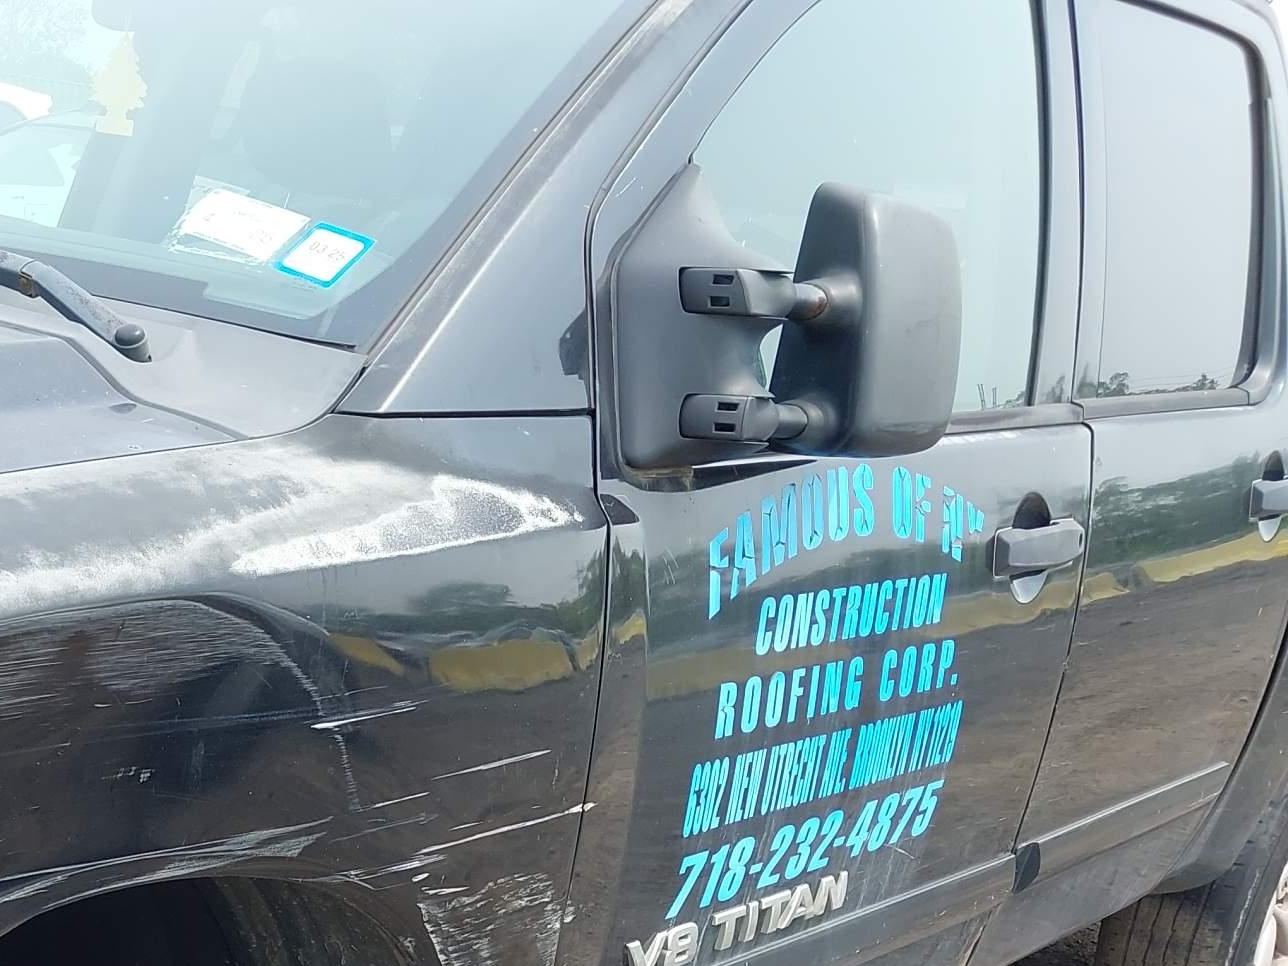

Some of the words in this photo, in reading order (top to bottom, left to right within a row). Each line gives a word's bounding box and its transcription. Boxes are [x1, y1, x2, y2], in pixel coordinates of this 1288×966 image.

[708, 463, 874, 620] FAMOUS
[892, 466, 931, 543] OF
[755, 573, 948, 656] CONSTRUCTION
[714, 656, 864, 740] ROOFING
[879, 640, 958, 702] CORP.
[682, 756, 730, 838] 6302
[724, 748, 768, 825] NEW
[760, 734, 827, 816] UTRECHT
[848, 711, 917, 790] BROOKLYN
[908, 707, 936, 774] NY
[665, 779, 945, 920] 718-232-4875
[712, 870, 849, 951] TITAN
